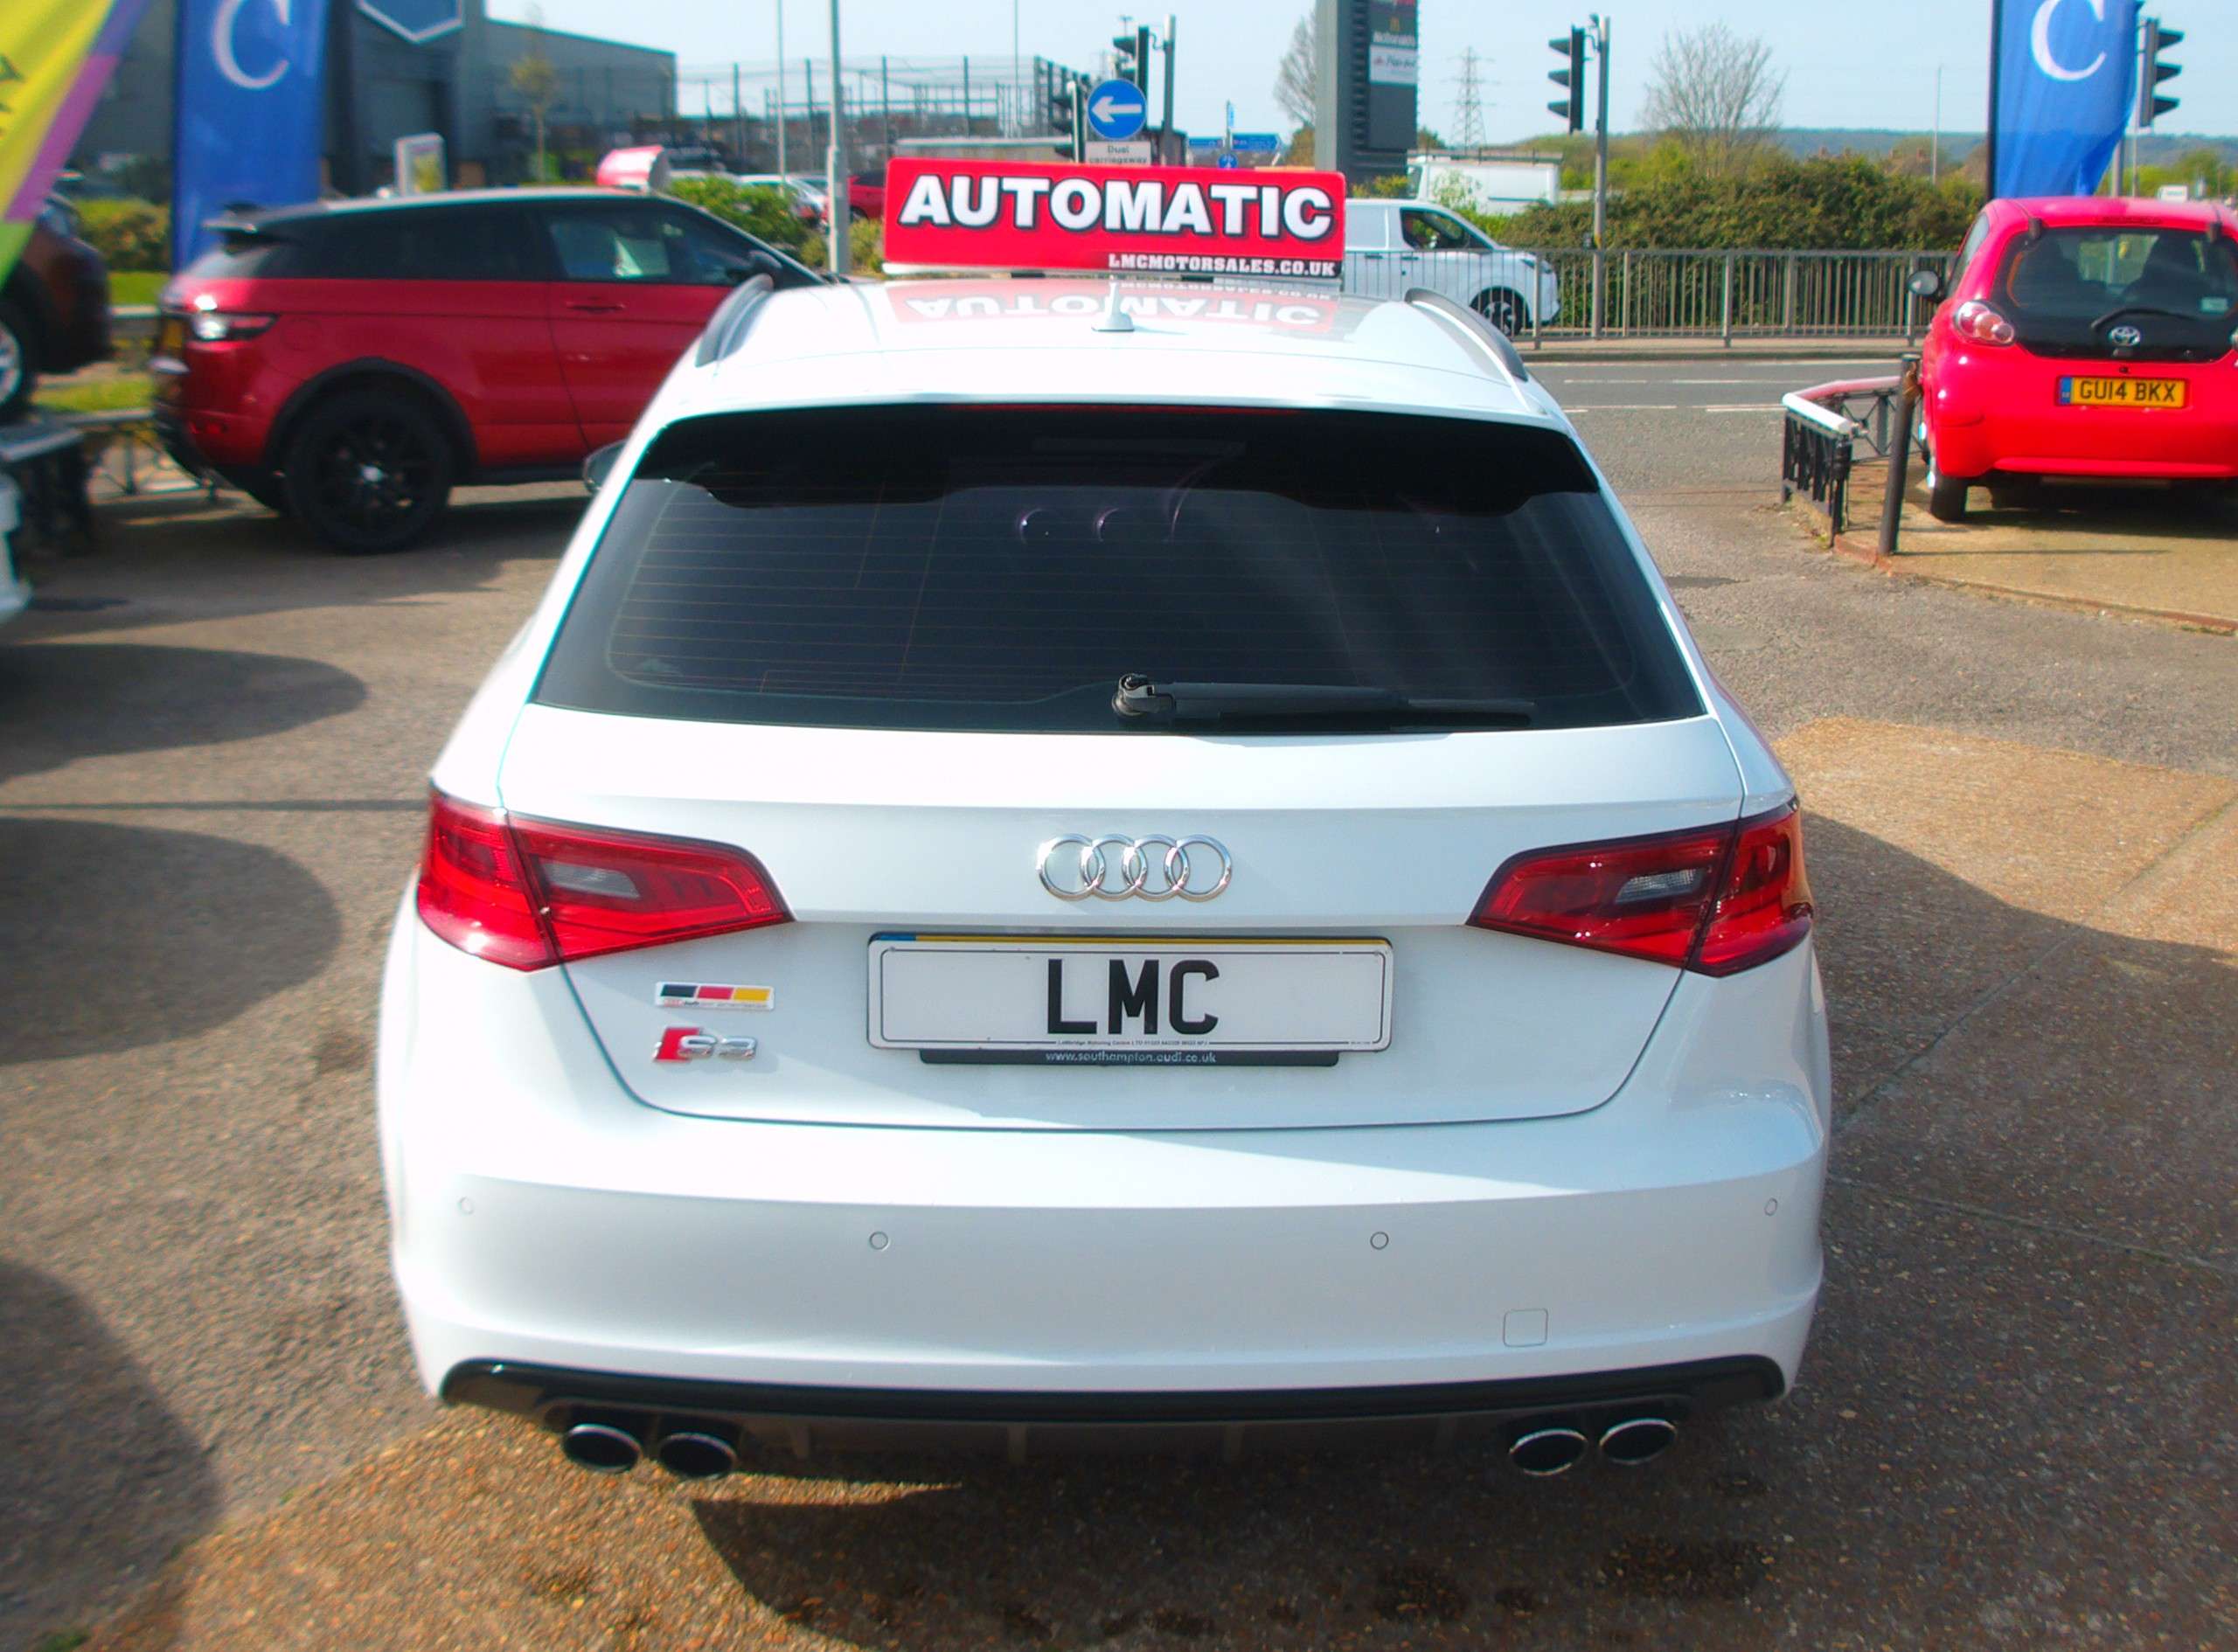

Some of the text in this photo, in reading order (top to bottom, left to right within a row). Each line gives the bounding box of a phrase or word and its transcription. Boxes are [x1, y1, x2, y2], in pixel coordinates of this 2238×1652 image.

[898, 174, 1333, 240] AUTOMATIC
[1108, 253, 1337, 277] LMCMOTORSALES.CO.UK
[2080, 379, 2177, 402] GU14 BKX
[1047, 958, 1220, 1035] LMC
[1046, 1051, 1217, 1064] www.southampton.audi.co.uk
